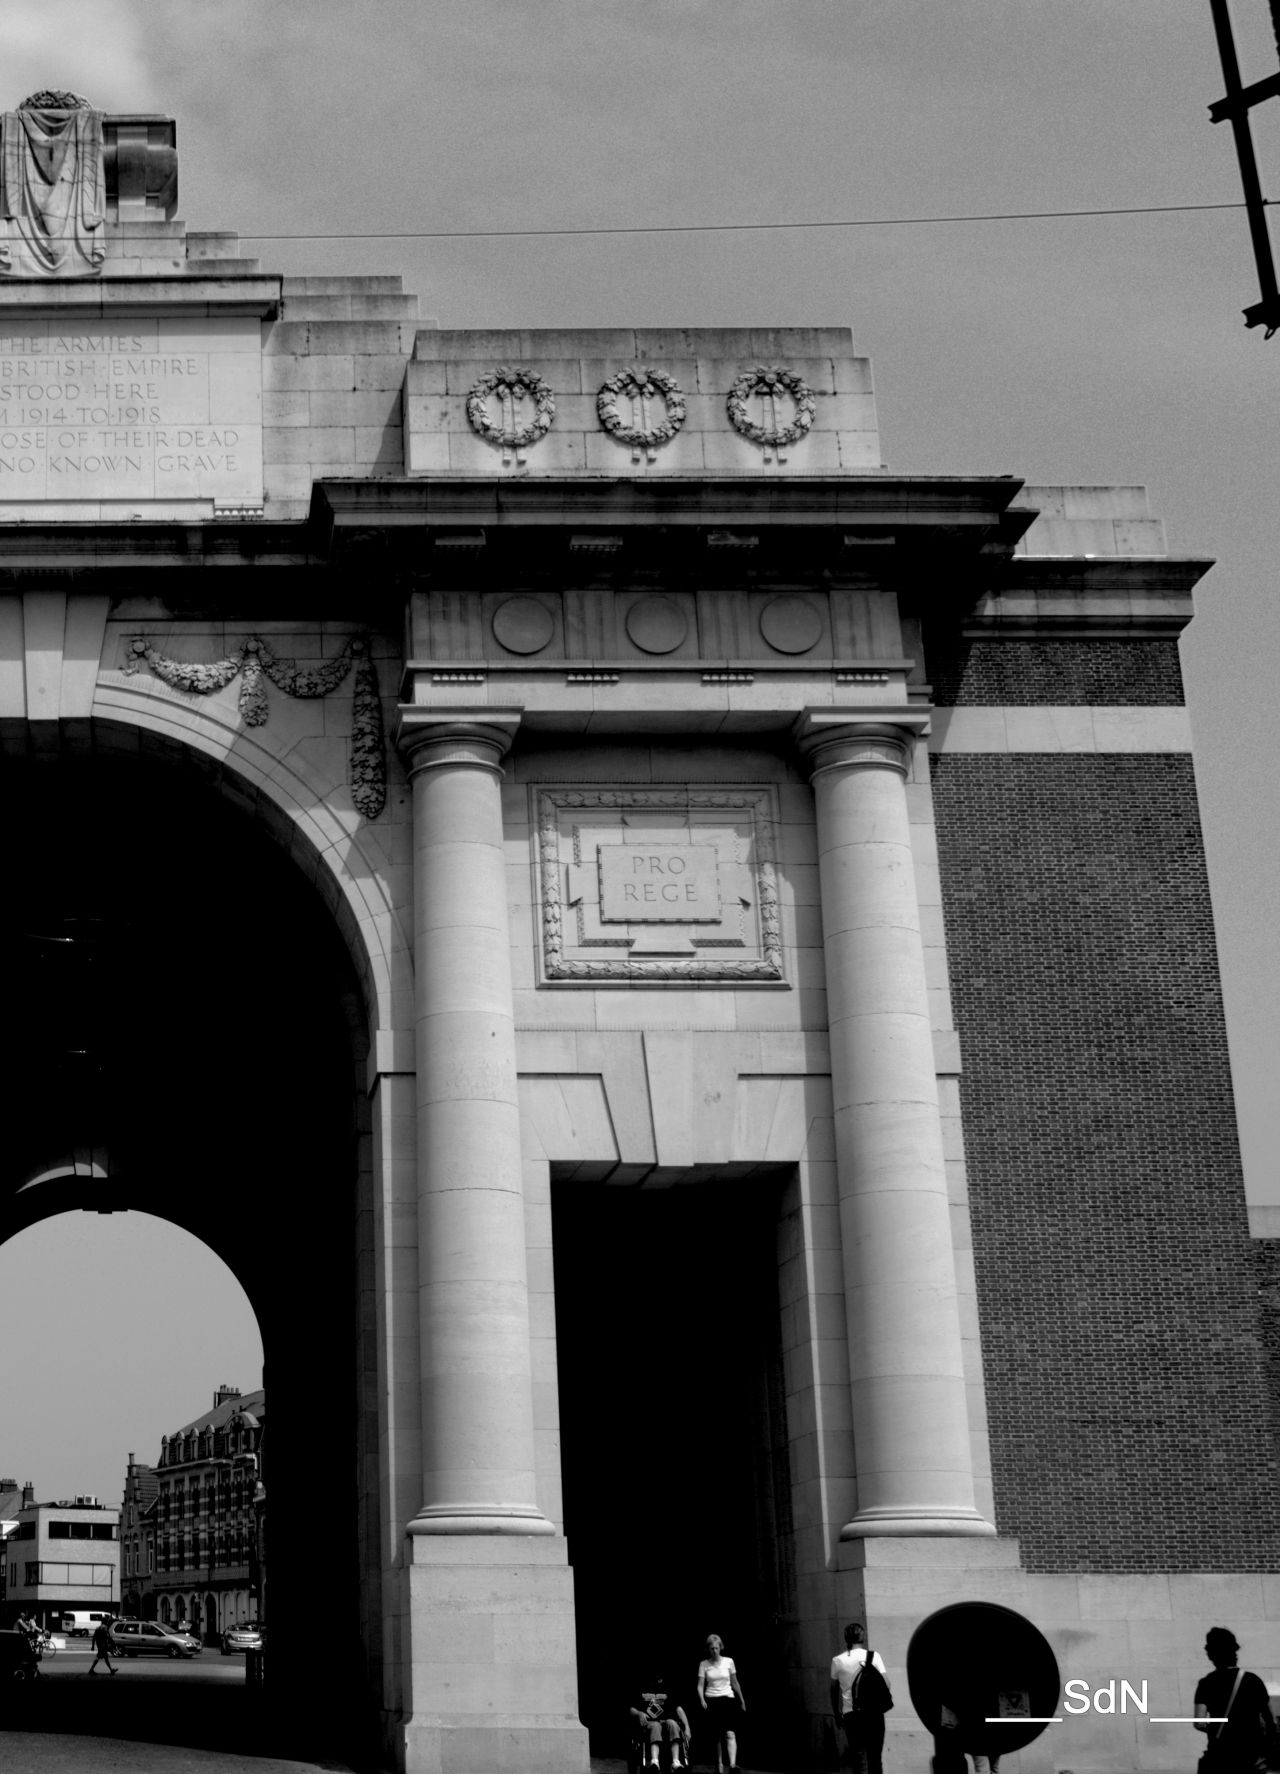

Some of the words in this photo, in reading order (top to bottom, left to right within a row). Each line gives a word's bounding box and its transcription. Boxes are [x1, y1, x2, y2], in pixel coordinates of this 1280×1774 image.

[54, 336, 144, 353] ARMIES
[1, 359, 96, 378] BRITISH
[112, 358, 199, 376] EMPIRE
[0, 383, 81, 401] STOOD
[93, 382, 159, 400] HERE
[20, 407, 68, 424] 1914
[76, 407, 109, 424] TO
[118, 406, 161, 424] 1918
[57, 431, 89, 449] OF
[97, 430, 169, 448] THEIR
[177, 429, 240, 448] DEAD
[48, 455, 143, 473] KNOWN
[157, 454, 238, 473] GRAVE
[632, 856, 686, 875] PRO
[624, 883, 698, 903] REGE
